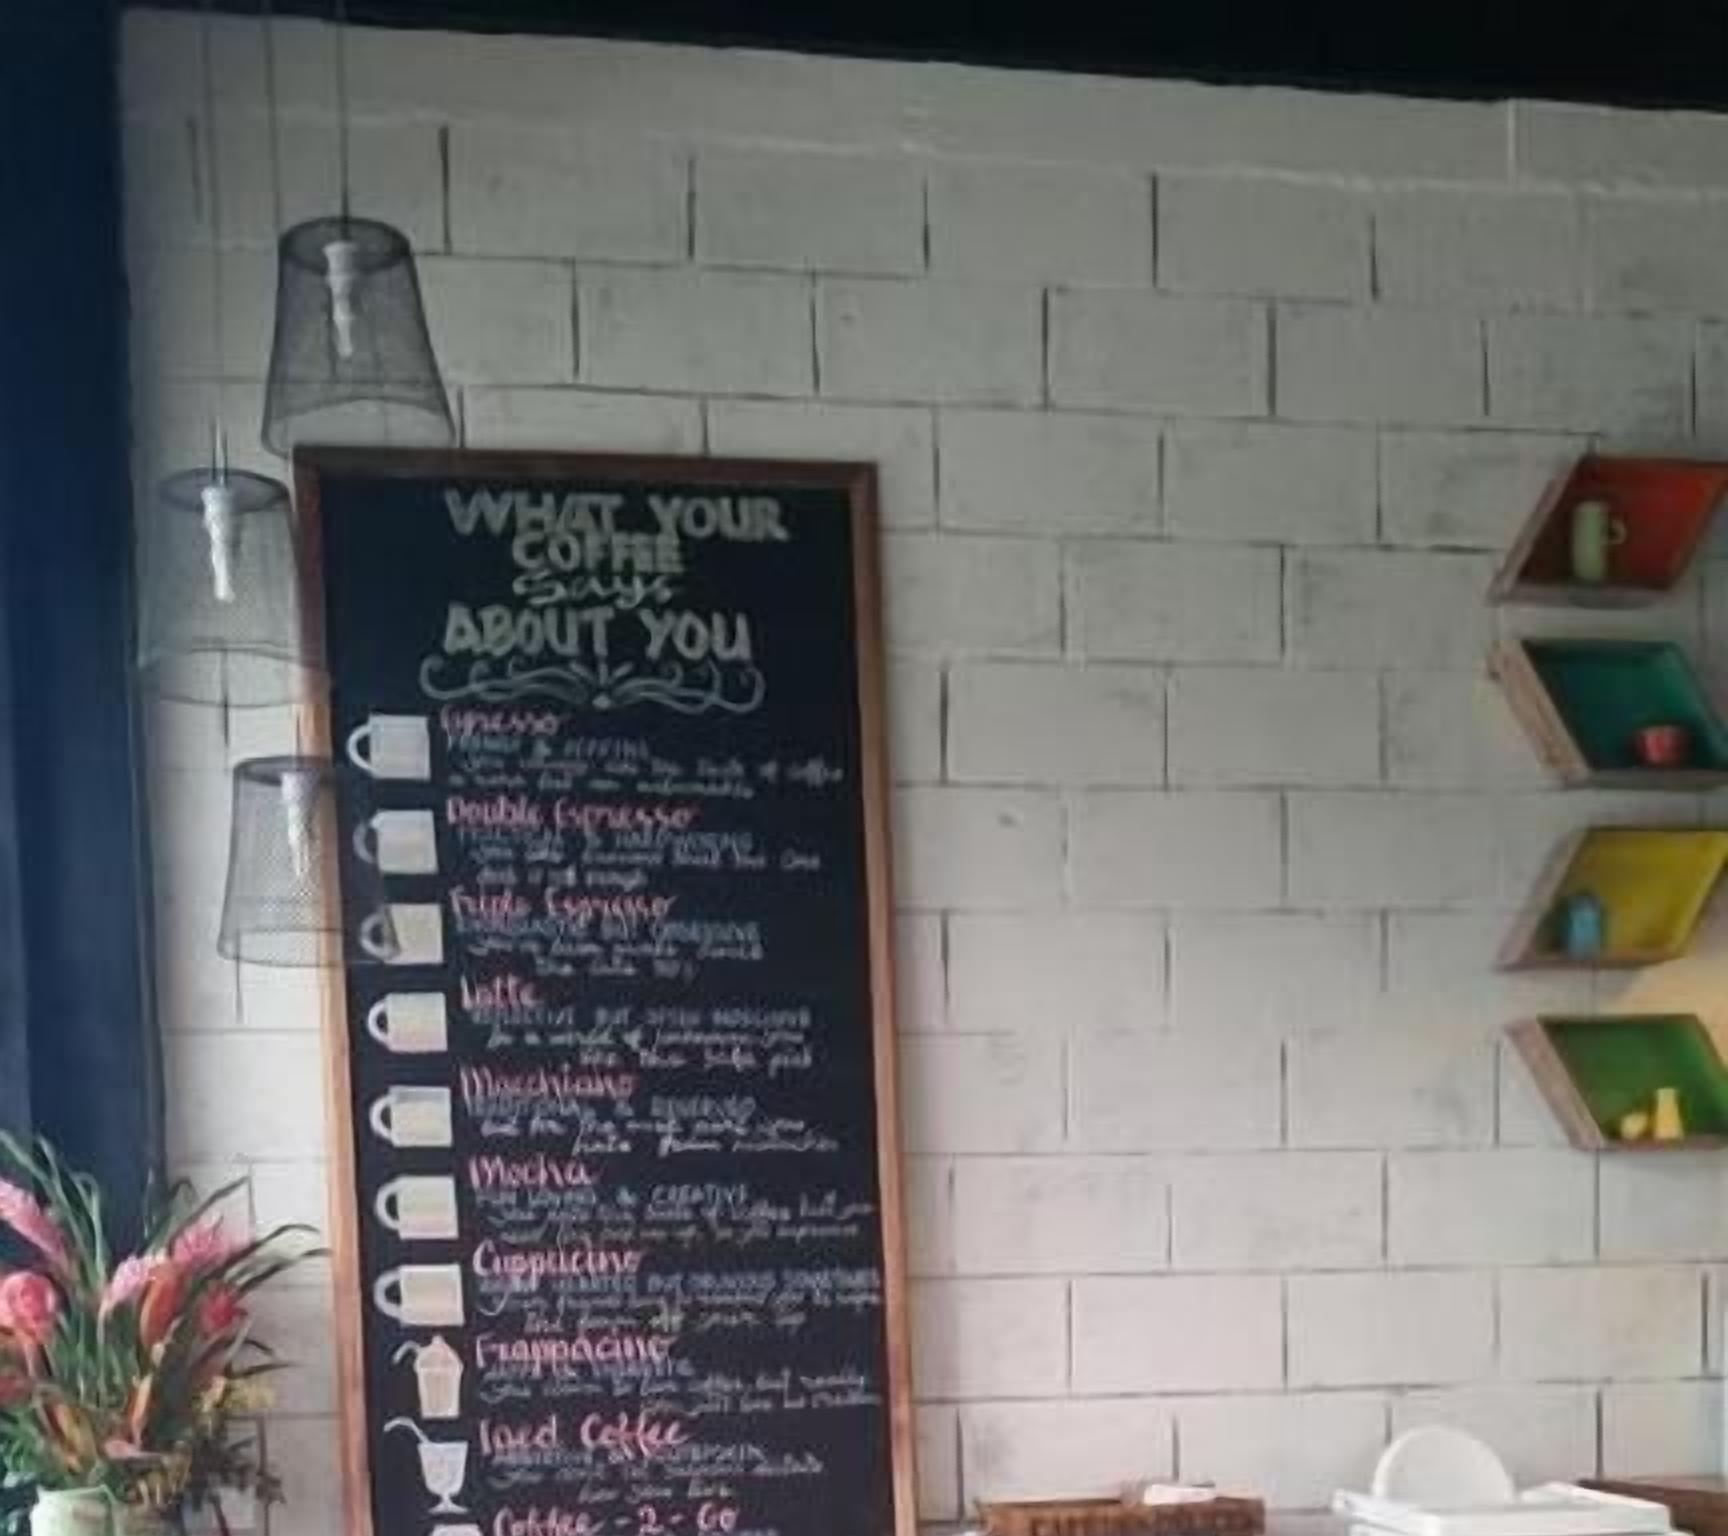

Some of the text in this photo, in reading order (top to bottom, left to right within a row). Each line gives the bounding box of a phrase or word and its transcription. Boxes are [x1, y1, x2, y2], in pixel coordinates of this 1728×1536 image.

[446, 487, 790, 542] WHAT YOUR
[512, 532, 685, 574] COFFEE
[444, 603, 752, 661] ABOUT YOU
[580, 1411, 692, 1459] Coffee
